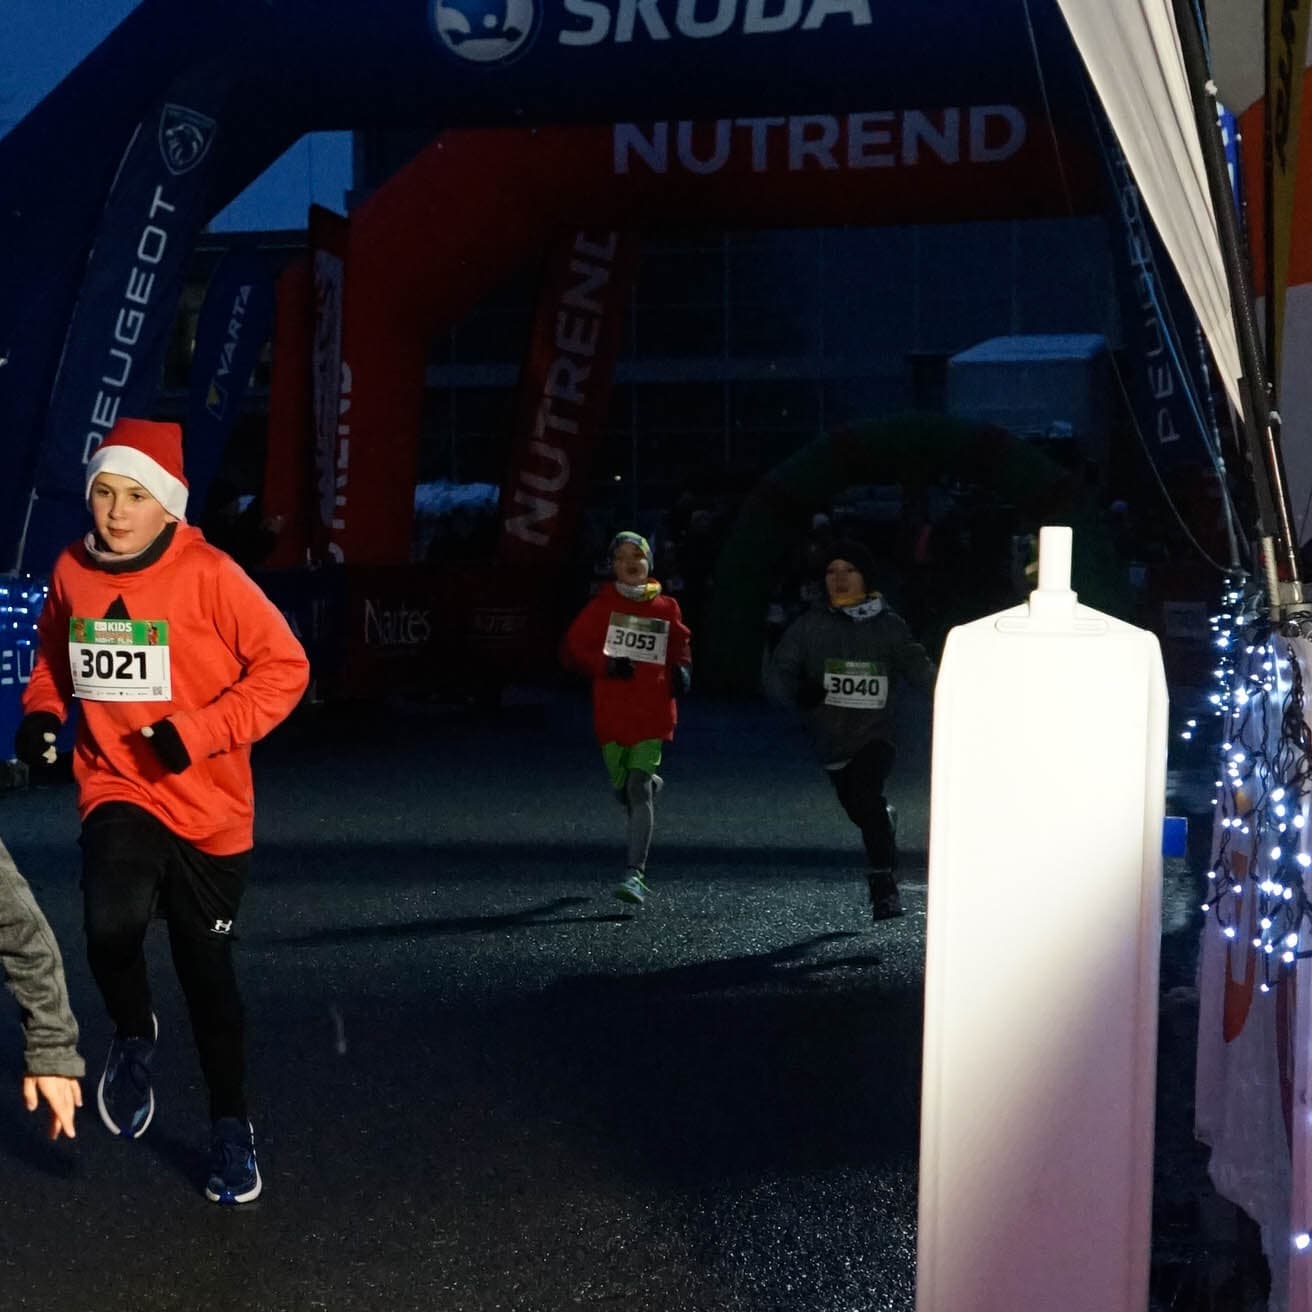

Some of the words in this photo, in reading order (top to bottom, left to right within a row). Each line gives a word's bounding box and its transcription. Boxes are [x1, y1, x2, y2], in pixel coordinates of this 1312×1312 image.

[612, 104, 1027, 176] NUTREND
[613, 629, 656, 650] 3053
[80, 649, 147, 680] 3021
[831, 677, 879, 696] 3040
